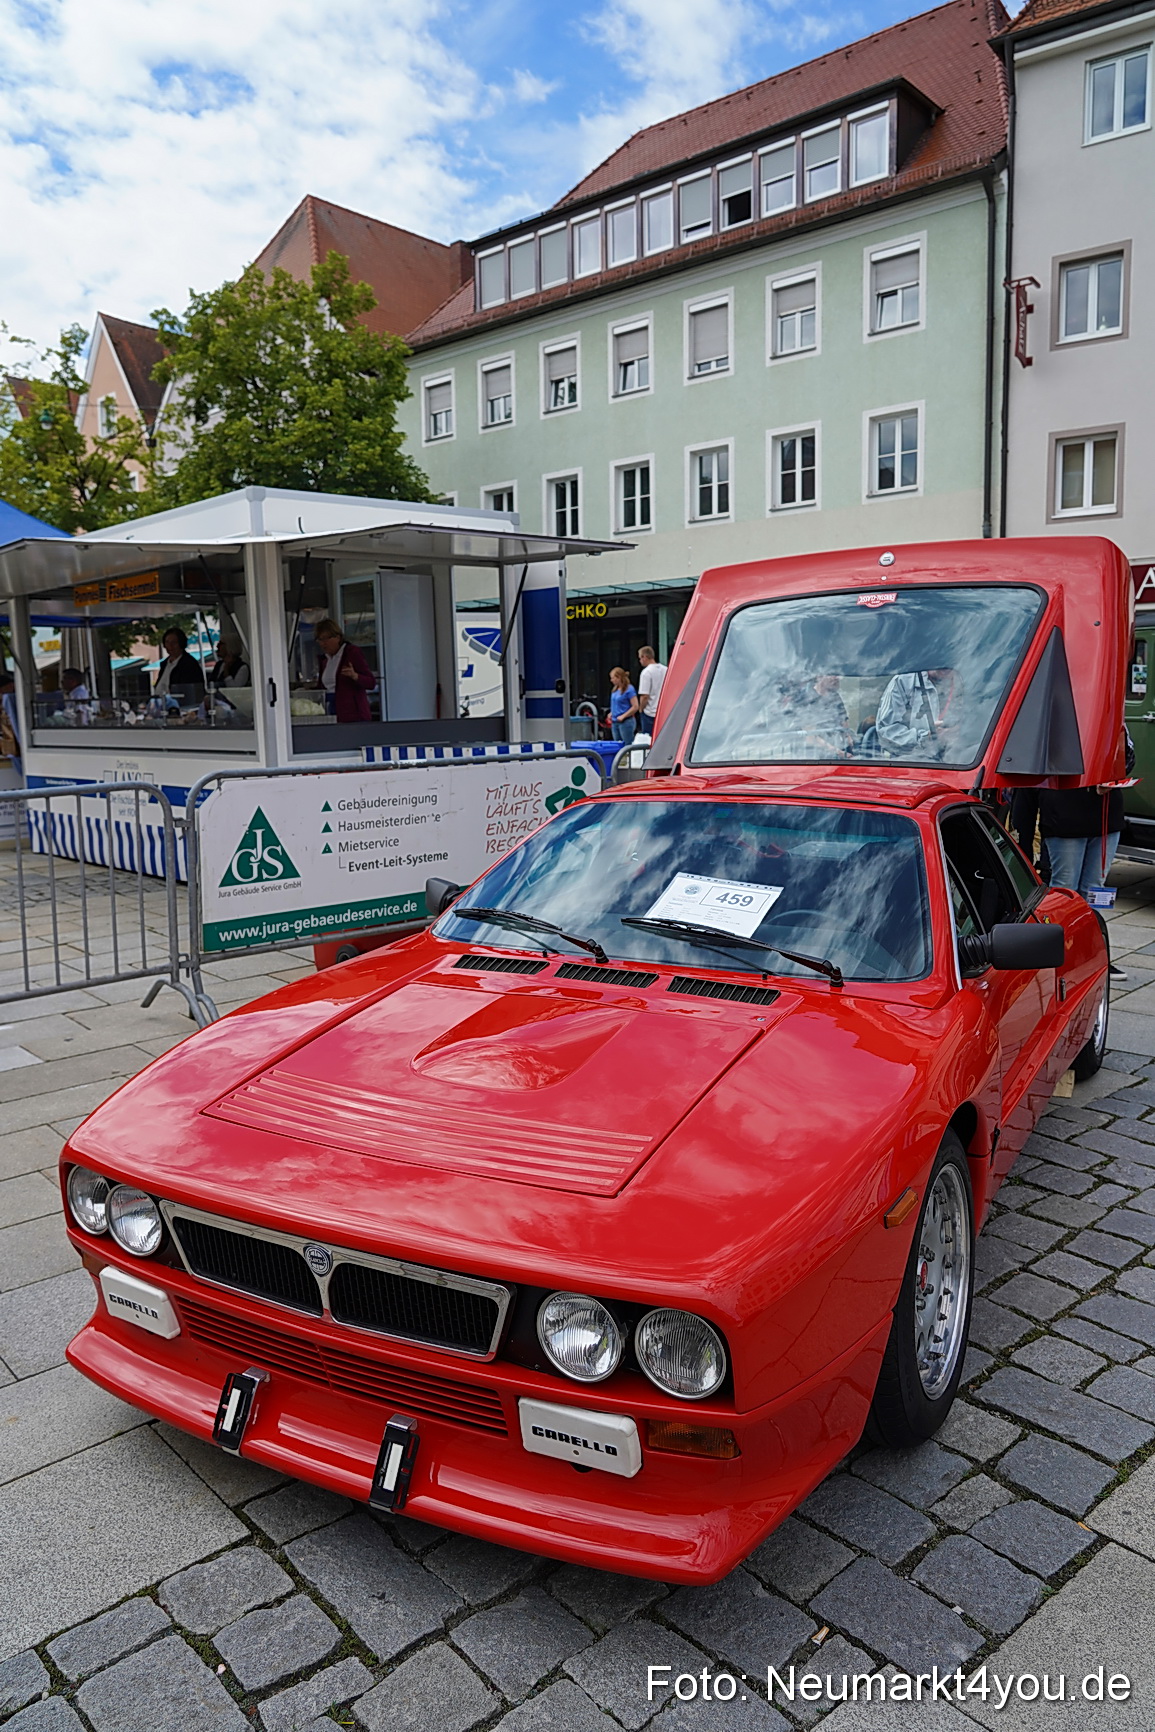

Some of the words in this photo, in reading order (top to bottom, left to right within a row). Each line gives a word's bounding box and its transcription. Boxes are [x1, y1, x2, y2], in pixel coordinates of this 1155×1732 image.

[109, 576, 158, 599] Fischsemmel
[512, 782, 542, 798] UNS
[337, 794, 438, 811] Gebäudereinigung
[338, 813, 441, 832] Hausmeisterdiene
[338, 837, 400, 853] Mietservice
[348, 851, 449, 873] Event-Leit-Systeme
[218, 890, 231, 898] Jura
[232, 885, 260, 896] Gebäude
[261, 883, 282, 893] Service
[283, 881, 302, 890] GmbH
[716, 892, 754, 907] 459
[218, 900, 418, 942] www.jura-gebaeudeservice.de
[108, 1293, 159, 1319] CARELLO
[531, 1425, 618, 1457] CARELLO
